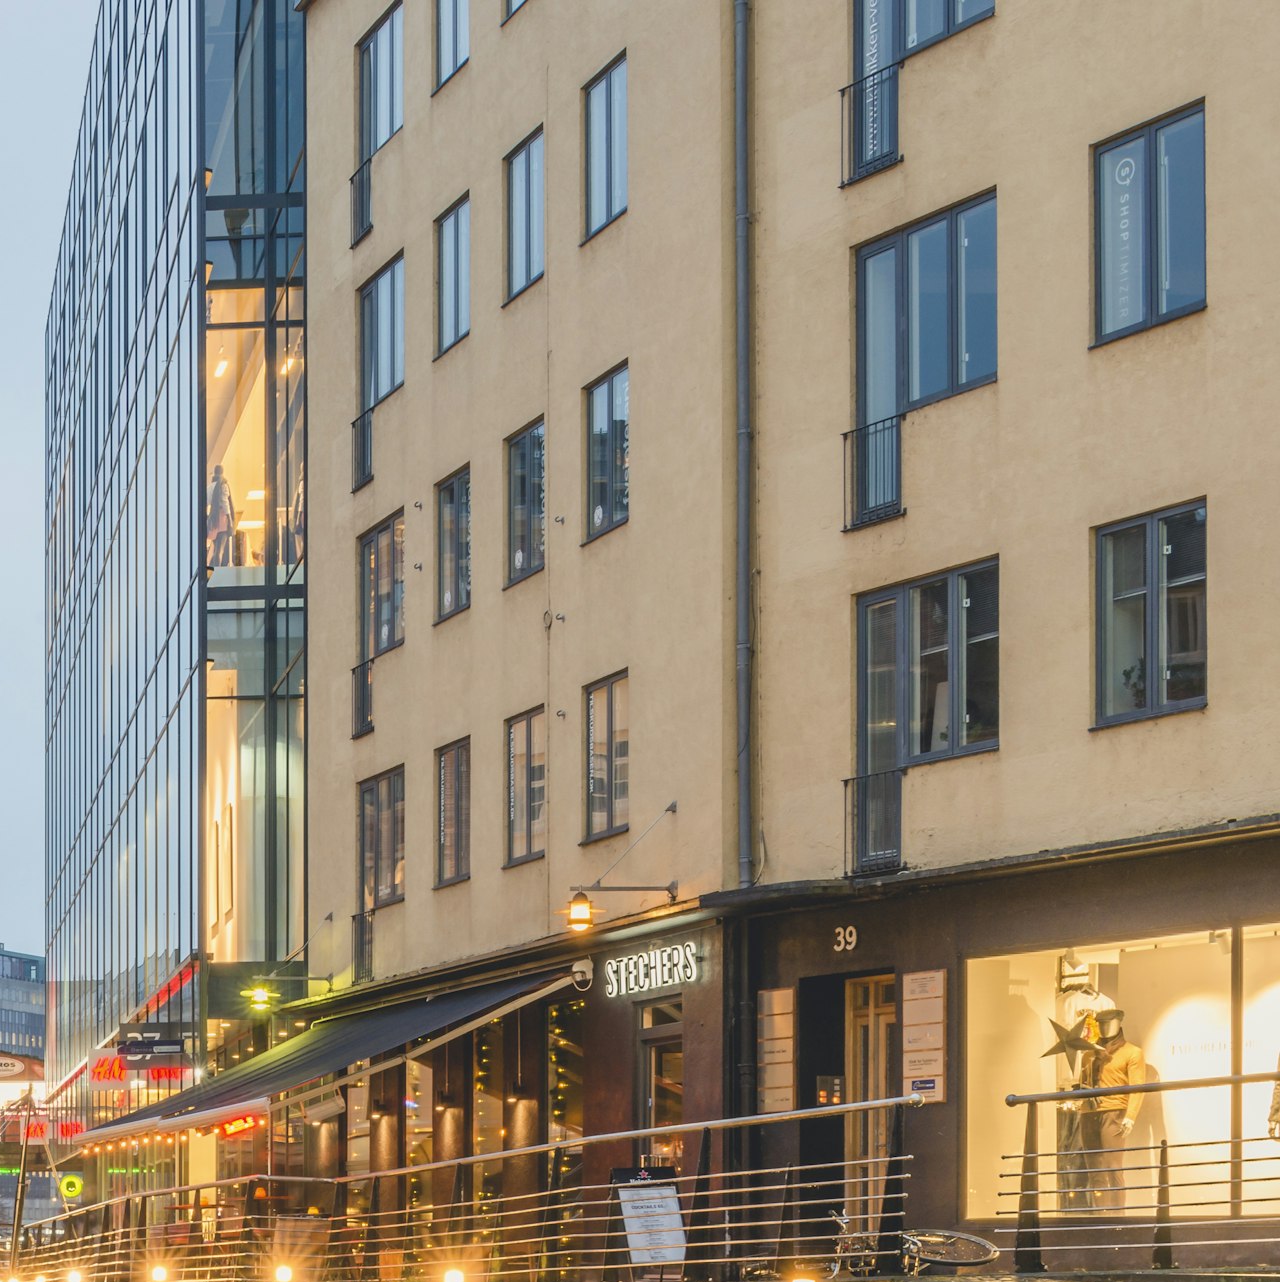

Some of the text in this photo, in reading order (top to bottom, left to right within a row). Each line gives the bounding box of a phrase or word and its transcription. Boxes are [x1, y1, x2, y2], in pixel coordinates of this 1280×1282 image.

[1120, 193, 1129, 318] SHOPTIMIZER
[833, 925, 857, 952] 39
[605, 941, 697, 998] STECHERS
[91, 1056, 127, 1082] H&M
